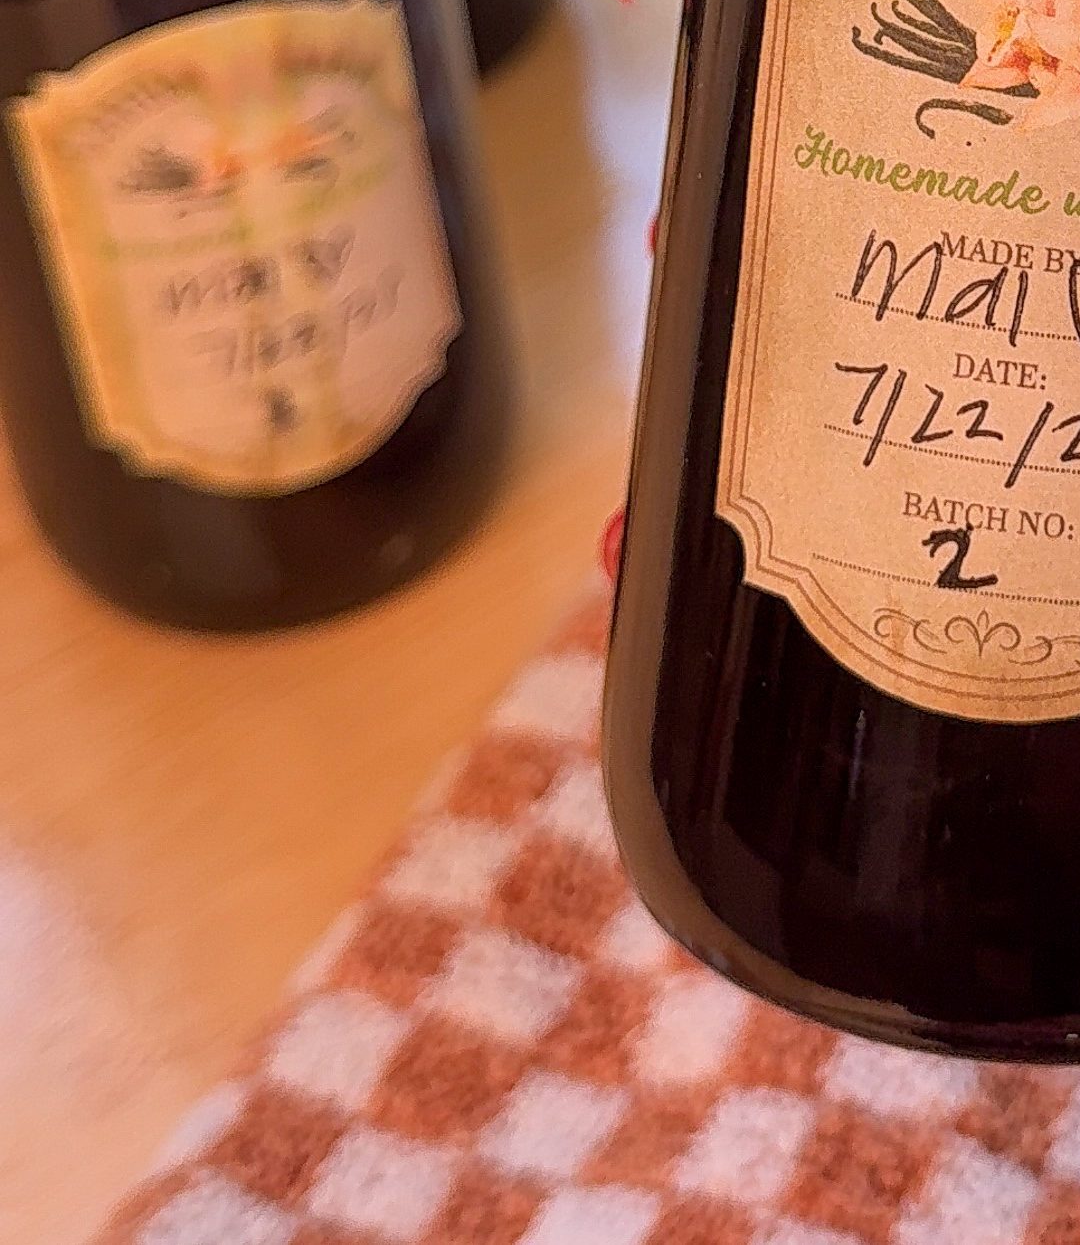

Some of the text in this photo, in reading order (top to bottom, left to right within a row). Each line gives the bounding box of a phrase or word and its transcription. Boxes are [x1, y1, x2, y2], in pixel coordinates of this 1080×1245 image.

[793, 124, 1050, 215] Homemade
[940, 231, 1034, 270] MADE
[953, 353, 1048, 391] DATE:
[902, 491, 1075, 541] BATCH NO:
[921, 523, 999, 590] 2
